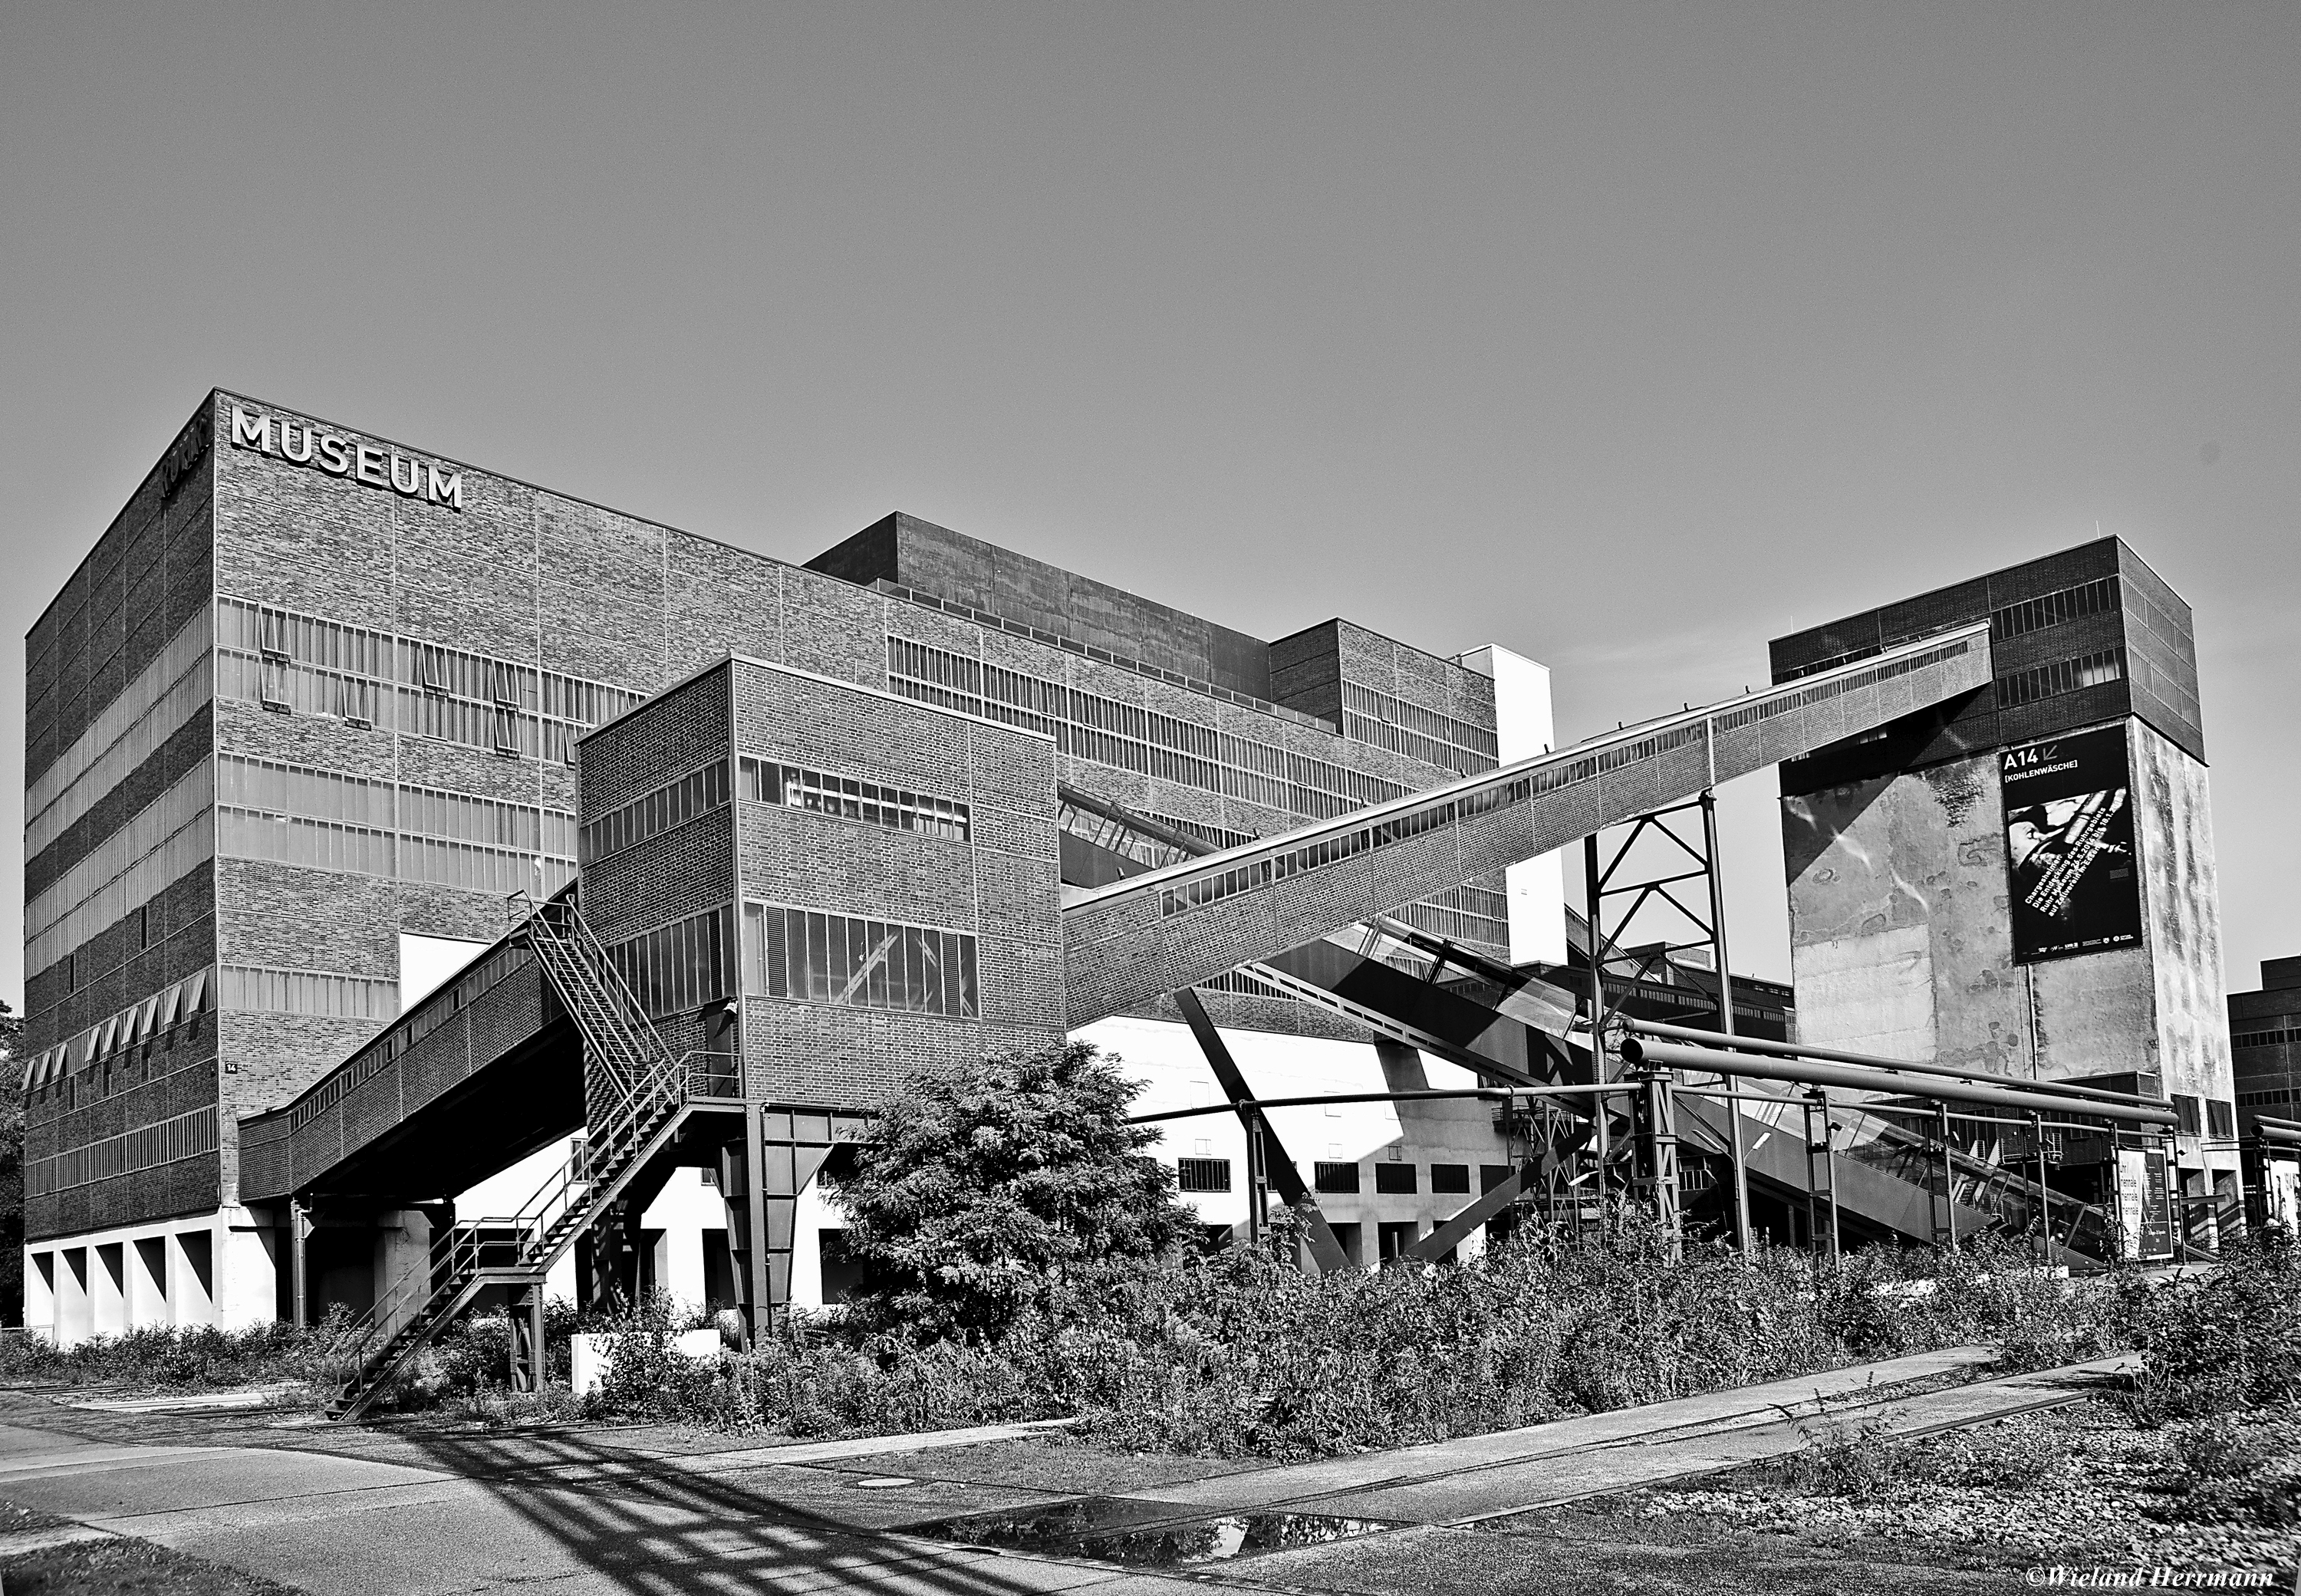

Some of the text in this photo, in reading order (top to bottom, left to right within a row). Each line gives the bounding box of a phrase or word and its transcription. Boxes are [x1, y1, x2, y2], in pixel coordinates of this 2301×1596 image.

[231, 405, 462, 509] MUSEUM
[2004, 749, 2038, 770] A14
[2004, 759, 2078, 783] [KOHLENWÄSCHE]
[2032, 807, 2106, 908] Die Entdeckung des Ruhrgebiets
[2039, 896, 2054, 913] Ruhr
[2051, 868, 2074, 896] Museum
[2092, 827, 2102, 838] bis
[2049, 904, 2059, 916] auf
[2056, 873, 2082, 905] Zollverein
[2085, 845, 2101, 866] Essen
